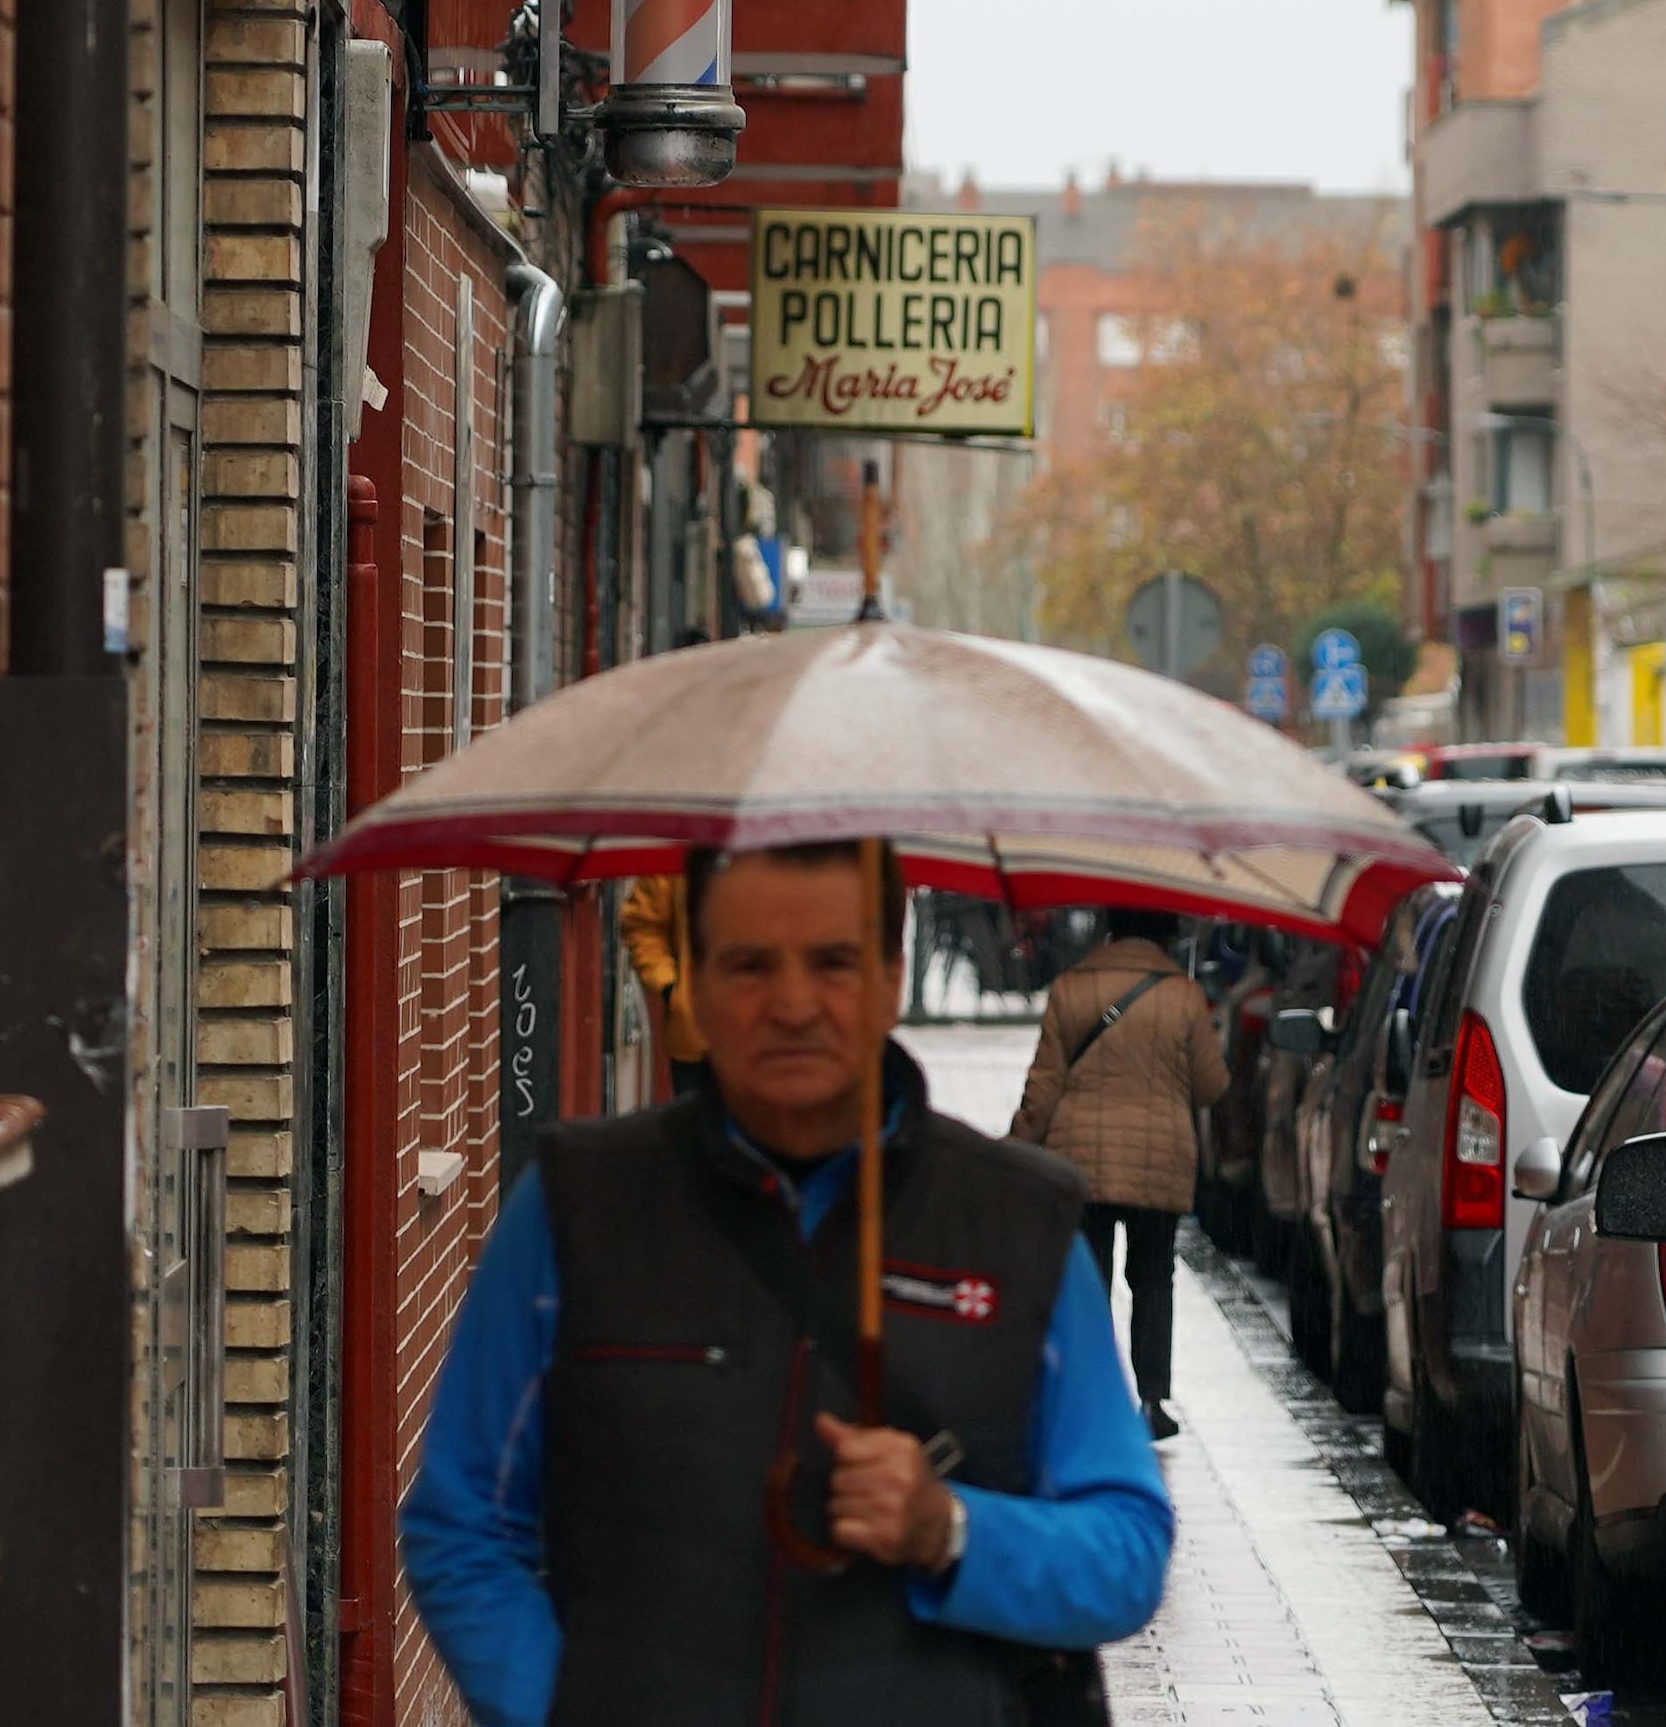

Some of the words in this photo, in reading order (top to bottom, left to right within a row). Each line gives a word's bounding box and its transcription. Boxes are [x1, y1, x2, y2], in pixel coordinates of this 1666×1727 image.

[764, 223, 1023, 285] CARNICERIA
[780, 289, 1002, 351] POLLERIA
[916, 356, 1015, 416] José
